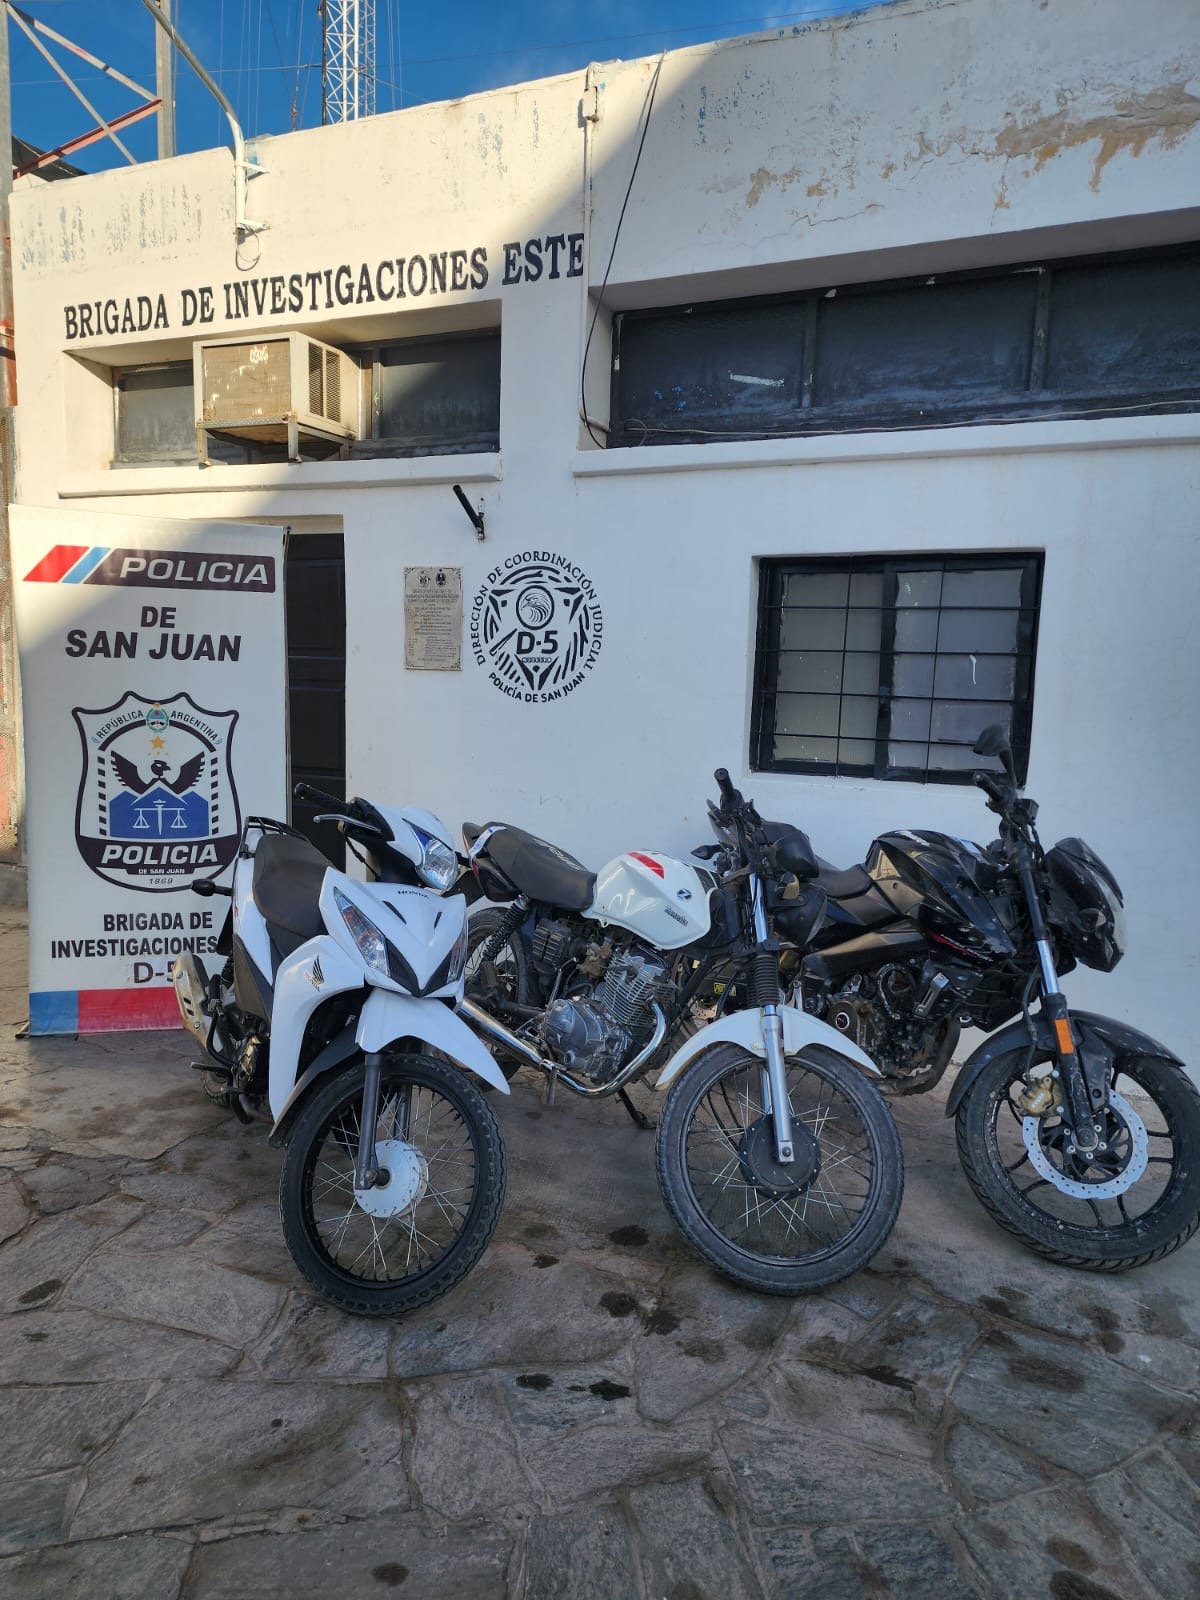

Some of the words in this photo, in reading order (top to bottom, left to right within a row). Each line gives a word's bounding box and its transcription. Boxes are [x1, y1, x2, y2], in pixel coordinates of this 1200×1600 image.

[64, 293, 170, 339] BRIGADA
[181, 285, 215, 327] DE
[223, 247, 488, 319] INVESTIGACIONES
[502, 232, 584, 285] ESTE
[119, 557, 268, 585] POLICIA
[141, 606, 176, 628] DE
[470, 585, 489, 666] DIRECCIÓN
[487, 566, 503, 584] DE
[504, 551, 597, 600] COORDINACIÓN
[583, 605, 603, 671] JUDICIAL
[65, 629, 138, 659] SAN
[148, 633, 242, 662] JUAN
[488, 672, 522, 701] POLICÍA
[525, 693, 538, 703] DE
[541, 690, 562, 703] SAN
[564, 671, 586, 696] JUAN
[96, 709, 144, 740] REPÚBLICA
[170, 710, 219, 742] ARGENTINA
[101, 844, 218, 866] POLICIA
[103, 912, 184, 932] BRIGADA
[189, 911, 213, 930] DE
[51, 936, 219, 959] INVESTIGACIONES
